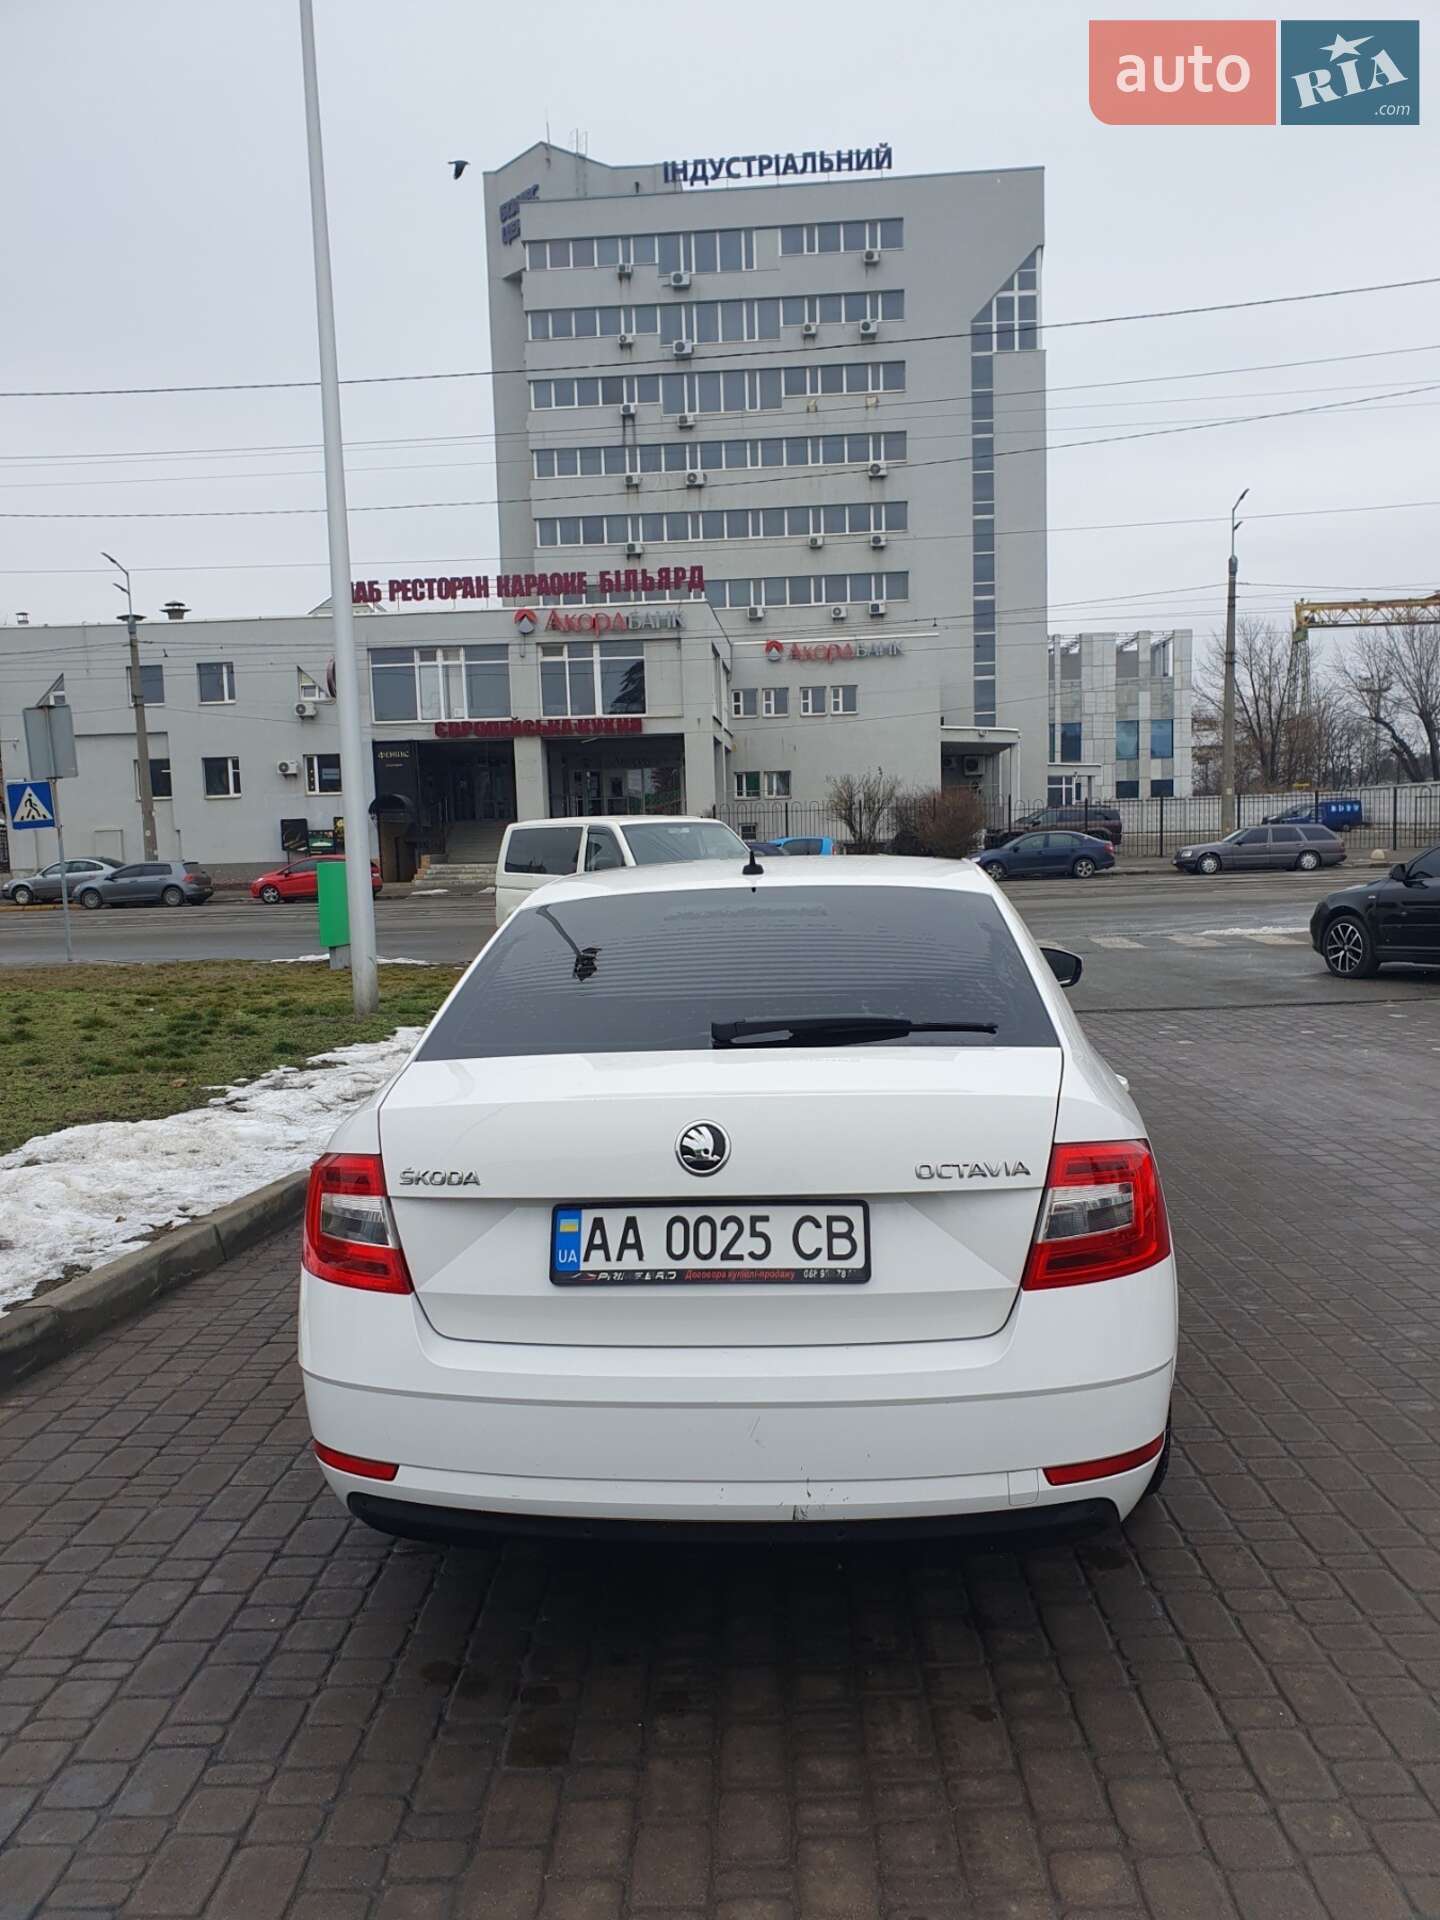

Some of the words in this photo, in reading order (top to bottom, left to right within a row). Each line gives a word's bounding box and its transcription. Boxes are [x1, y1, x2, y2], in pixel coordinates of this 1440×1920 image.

[663, 142, 893, 187] ІНДУСТРІАЛЬНИЙ
[388, 575, 489, 602] РЕСТОРАН
[496, 571, 588, 598] КАРАОКЕ
[599, 565, 705, 593] БІЛЬЯРД
[914, 1161, 1032, 1180] OCTAVIA
[558, 1248, 578, 1264] UA
[582, 1215, 645, 1263] AA
[665, 1214, 772, 1261] 0025
[791, 1214, 858, 1261] CB
